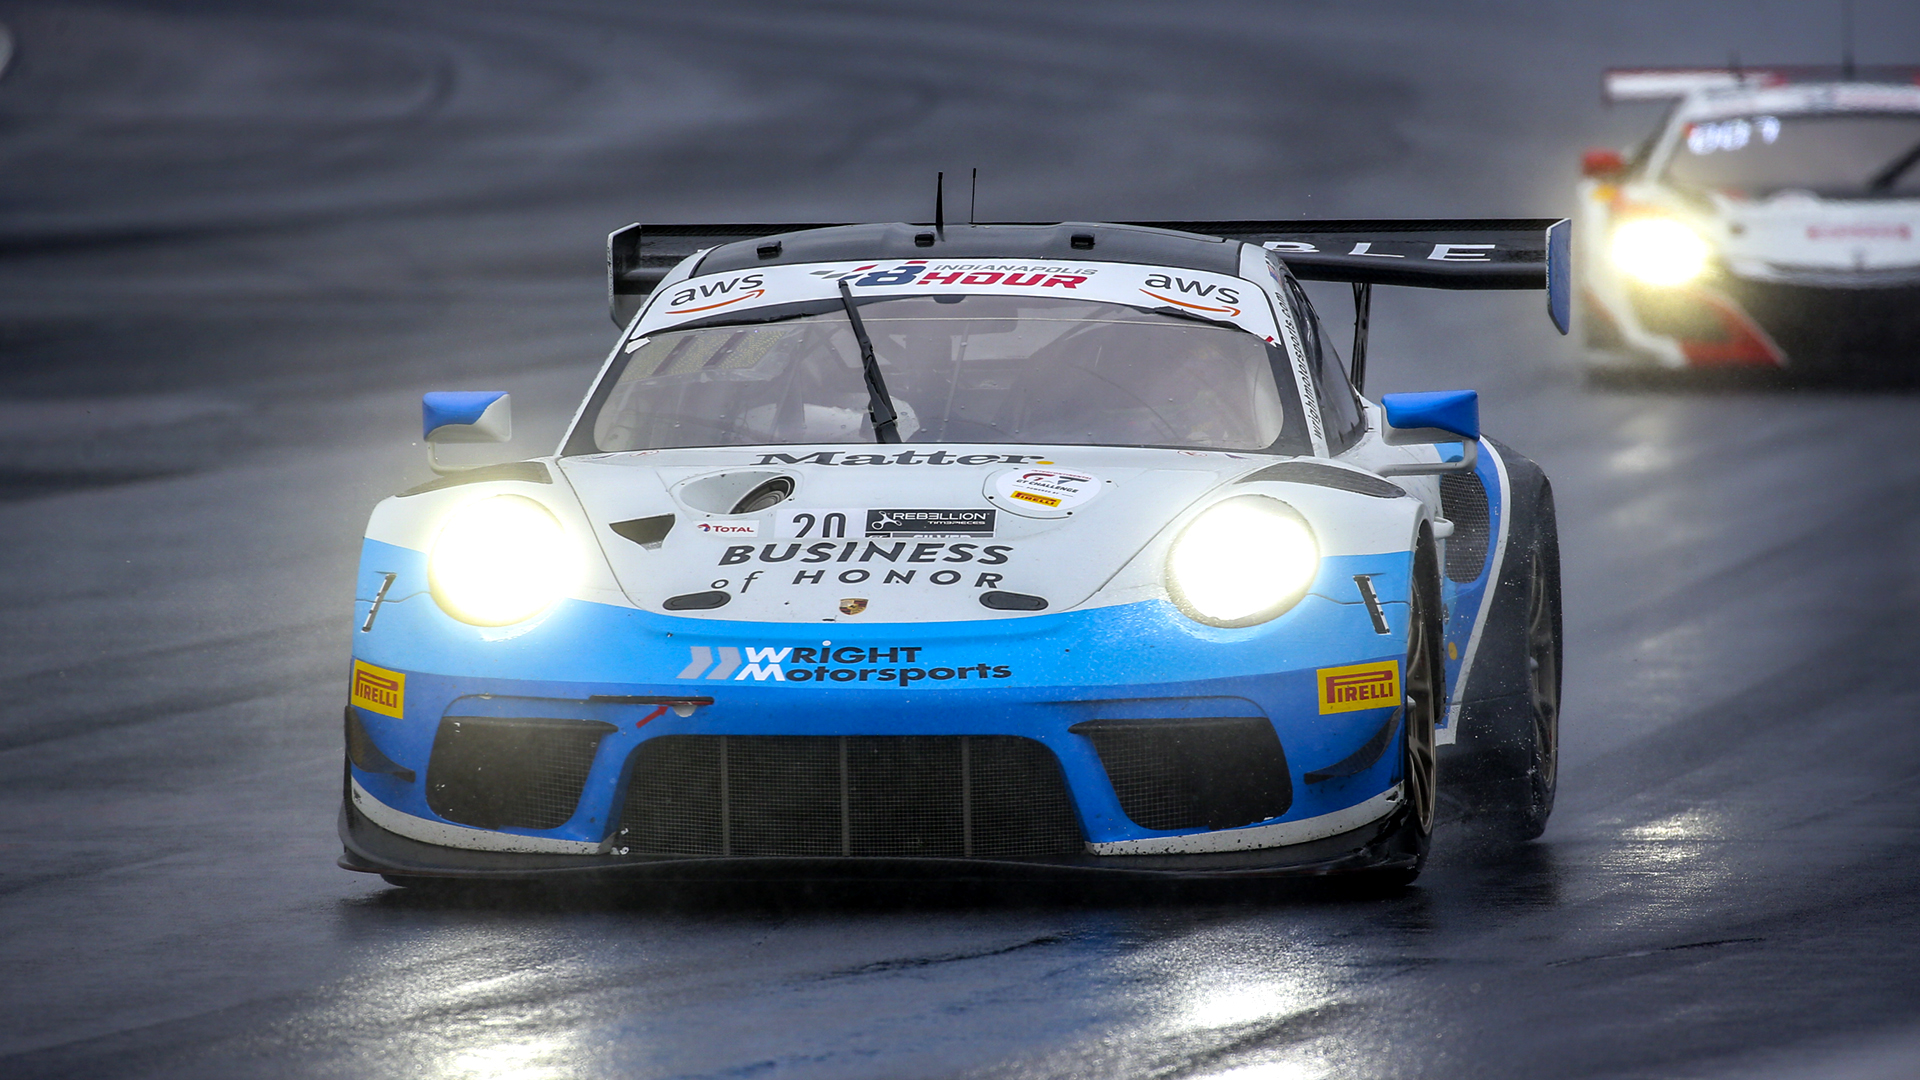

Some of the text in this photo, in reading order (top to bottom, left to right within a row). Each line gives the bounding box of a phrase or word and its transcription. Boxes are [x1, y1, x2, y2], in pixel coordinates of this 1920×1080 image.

[855, 265, 1089, 289] 8 HOUR
[934, 263, 1098, 275] INDIANAPOLIS
[671, 274, 765, 306] aws
[1145, 273, 1240, 305] aws
[1029, 480, 1079, 493] CHALLENGE
[1015, 492, 1057, 506] PIRELLI
[892, 512, 986, 520] REBELLION
[712, 525, 755, 533] TOTAL
[718, 541, 1014, 566] BUSINESS
[711, 569, 1003, 593] of HONOR
[745, 640, 922, 663] WRIGHT
[734, 662, 1013, 687] Motorsports
[355, 669, 399, 708] PIRELLI
[1325, 670, 1394, 704] PIRELLI
